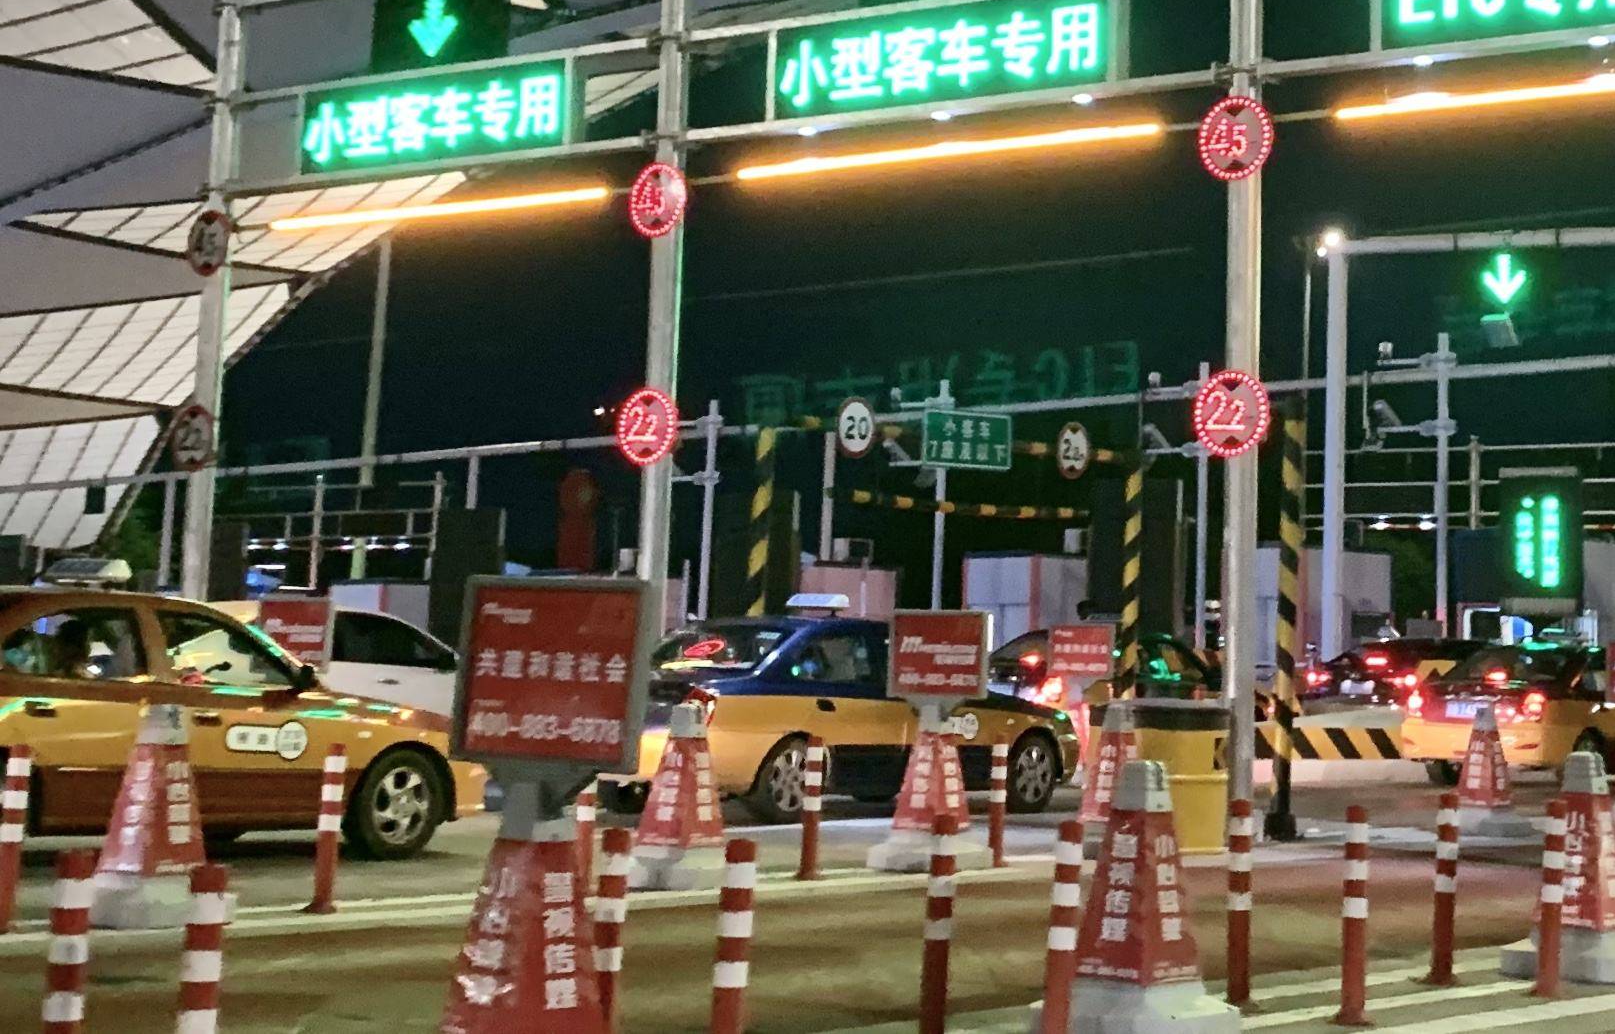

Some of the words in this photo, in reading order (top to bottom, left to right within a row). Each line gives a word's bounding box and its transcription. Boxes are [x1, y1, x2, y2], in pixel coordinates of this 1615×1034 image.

[779, 2, 1100, 107] 小型客车专用
[303, 74, 560, 164] 小型客车专用
[845, 415, 869, 441] 20
